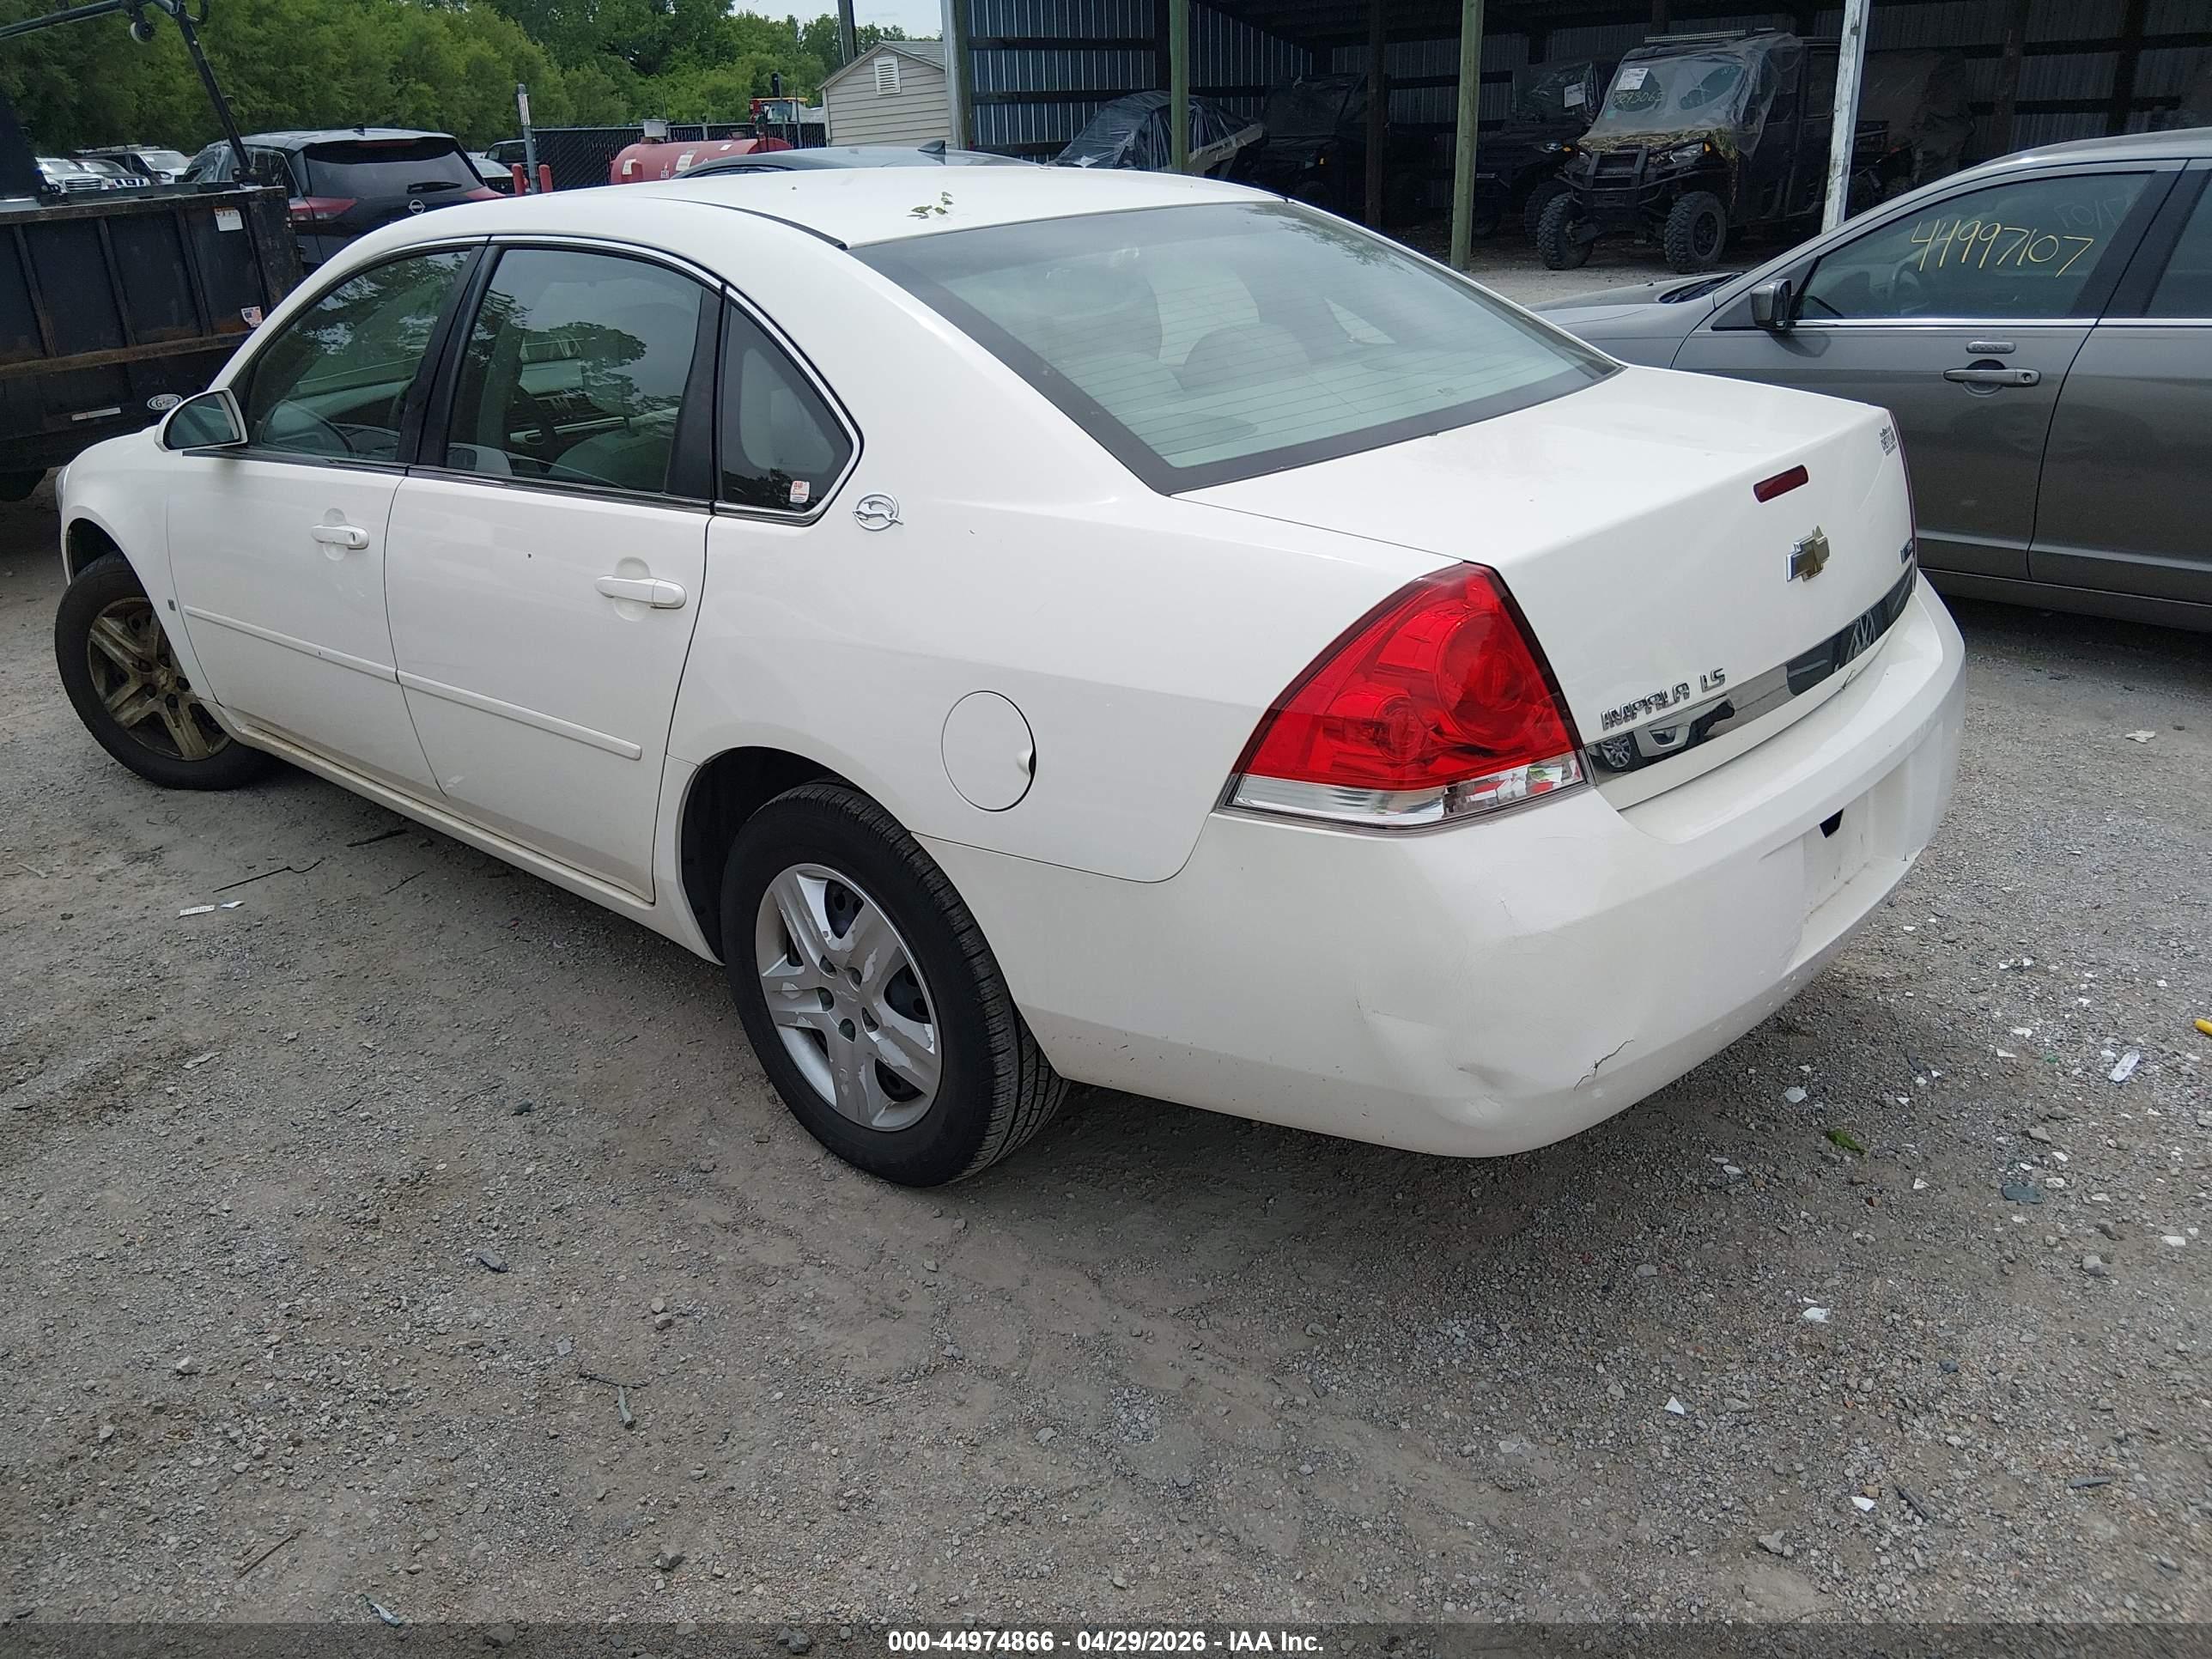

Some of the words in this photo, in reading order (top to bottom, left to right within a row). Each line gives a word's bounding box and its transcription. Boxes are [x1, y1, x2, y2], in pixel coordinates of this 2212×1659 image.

[1911, 218, 2095, 278] 44997107
[1601, 682, 1691, 731] IMPALA
[1699, 668, 1726, 693] LS
